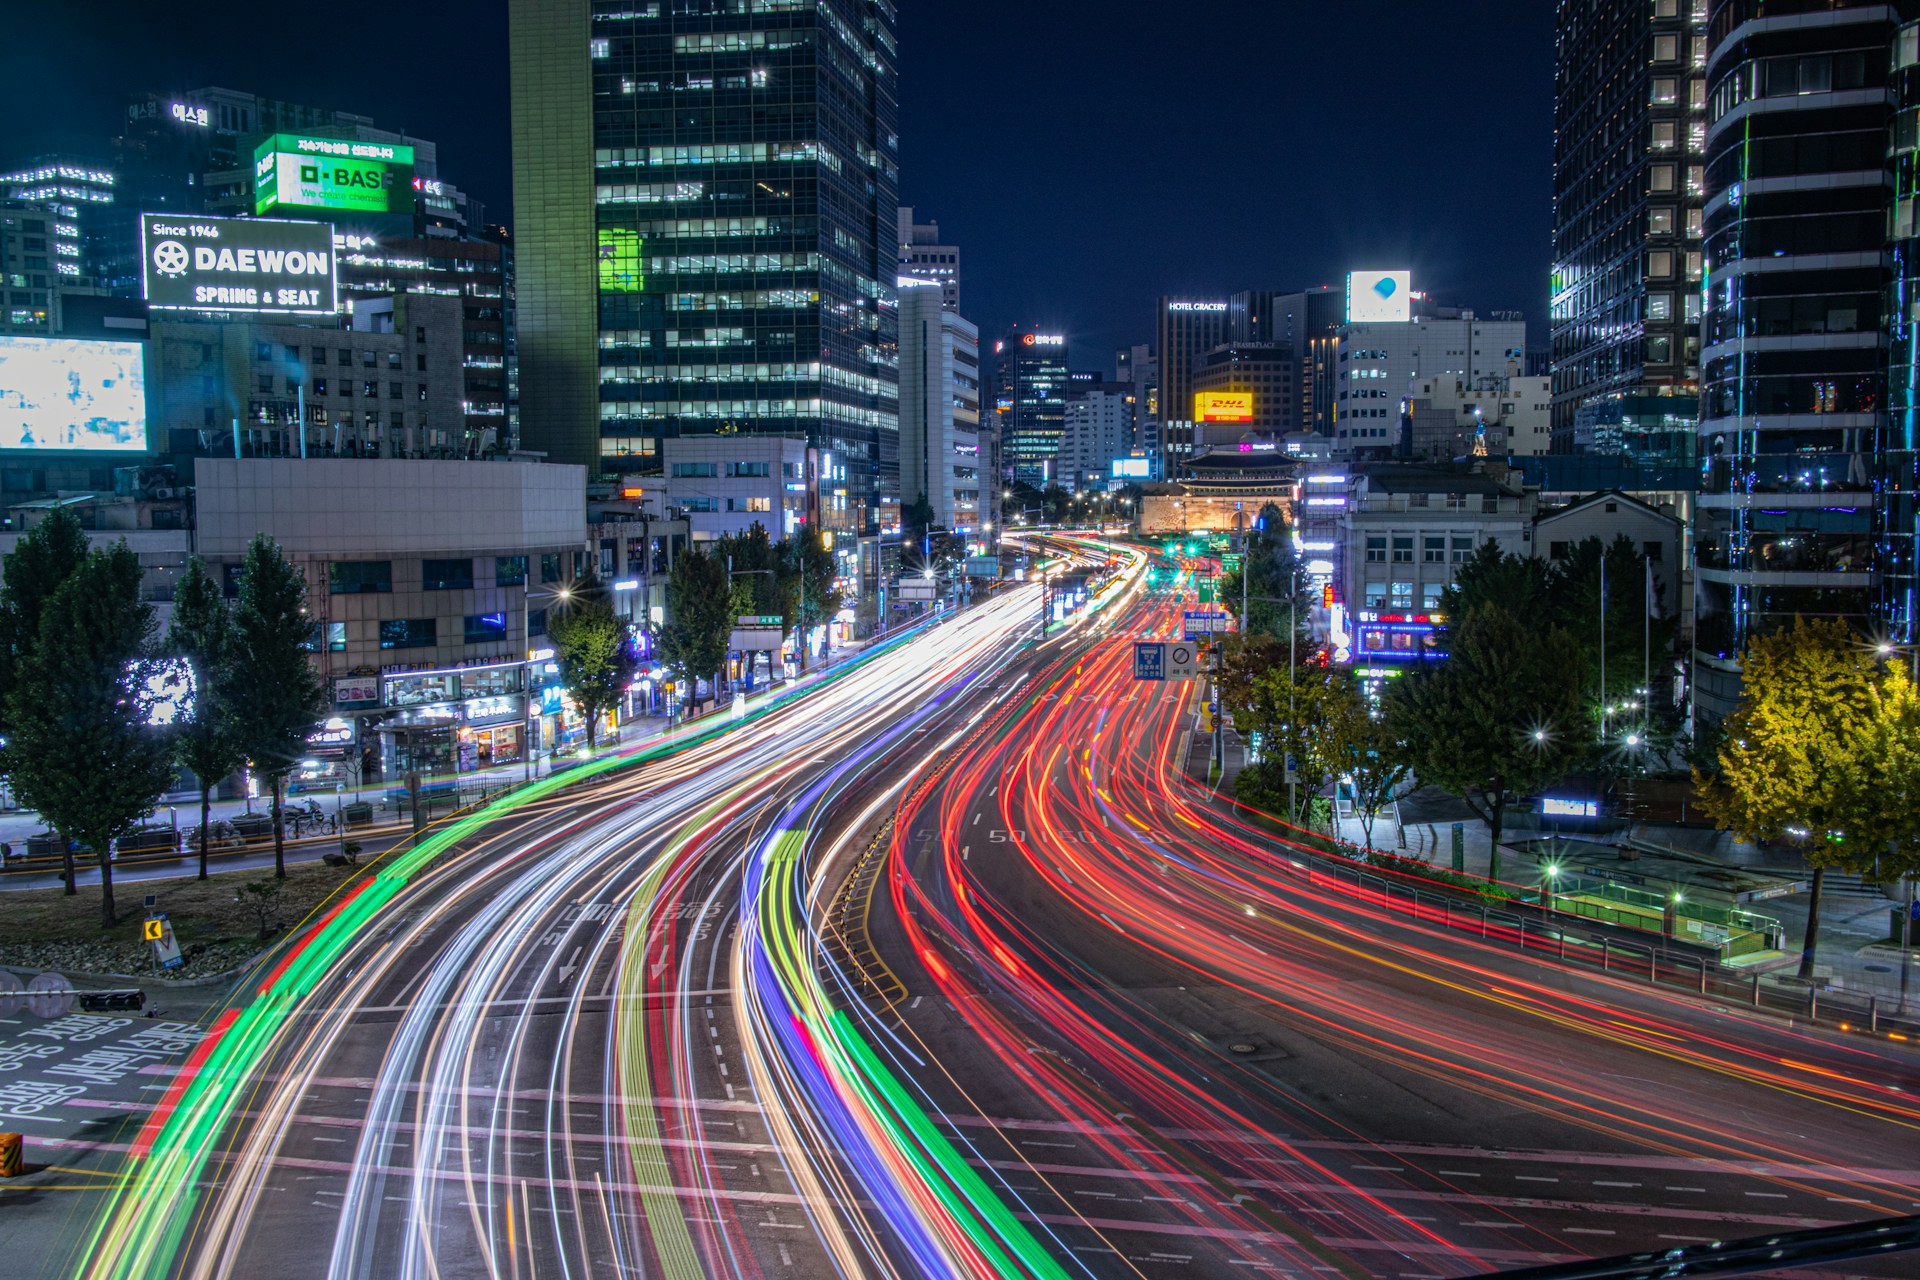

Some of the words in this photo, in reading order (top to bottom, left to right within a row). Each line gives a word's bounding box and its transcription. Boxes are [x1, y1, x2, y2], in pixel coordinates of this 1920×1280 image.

[172, 103, 208, 126] 에스원
[334, 168, 394, 190] BASF
[302, 188, 316, 198] We
[318, 190, 346, 201] create
[153, 223, 187, 236] Since
[189, 225, 219, 238] 1946
[195, 247, 328, 275] DAEWON
[195, 286, 257, 305] SPRING
[262, 291, 273, 304] &
[277, 289, 320, 306] SEAT
[1169, 303, 1193, 311] HOTEL
[1193, 303, 1227, 311] GRACERY
[1211, 400, 1245, 408] DHL
[988, 829, 1026, 843] 50
[1058, 829, 1098, 843] 50
